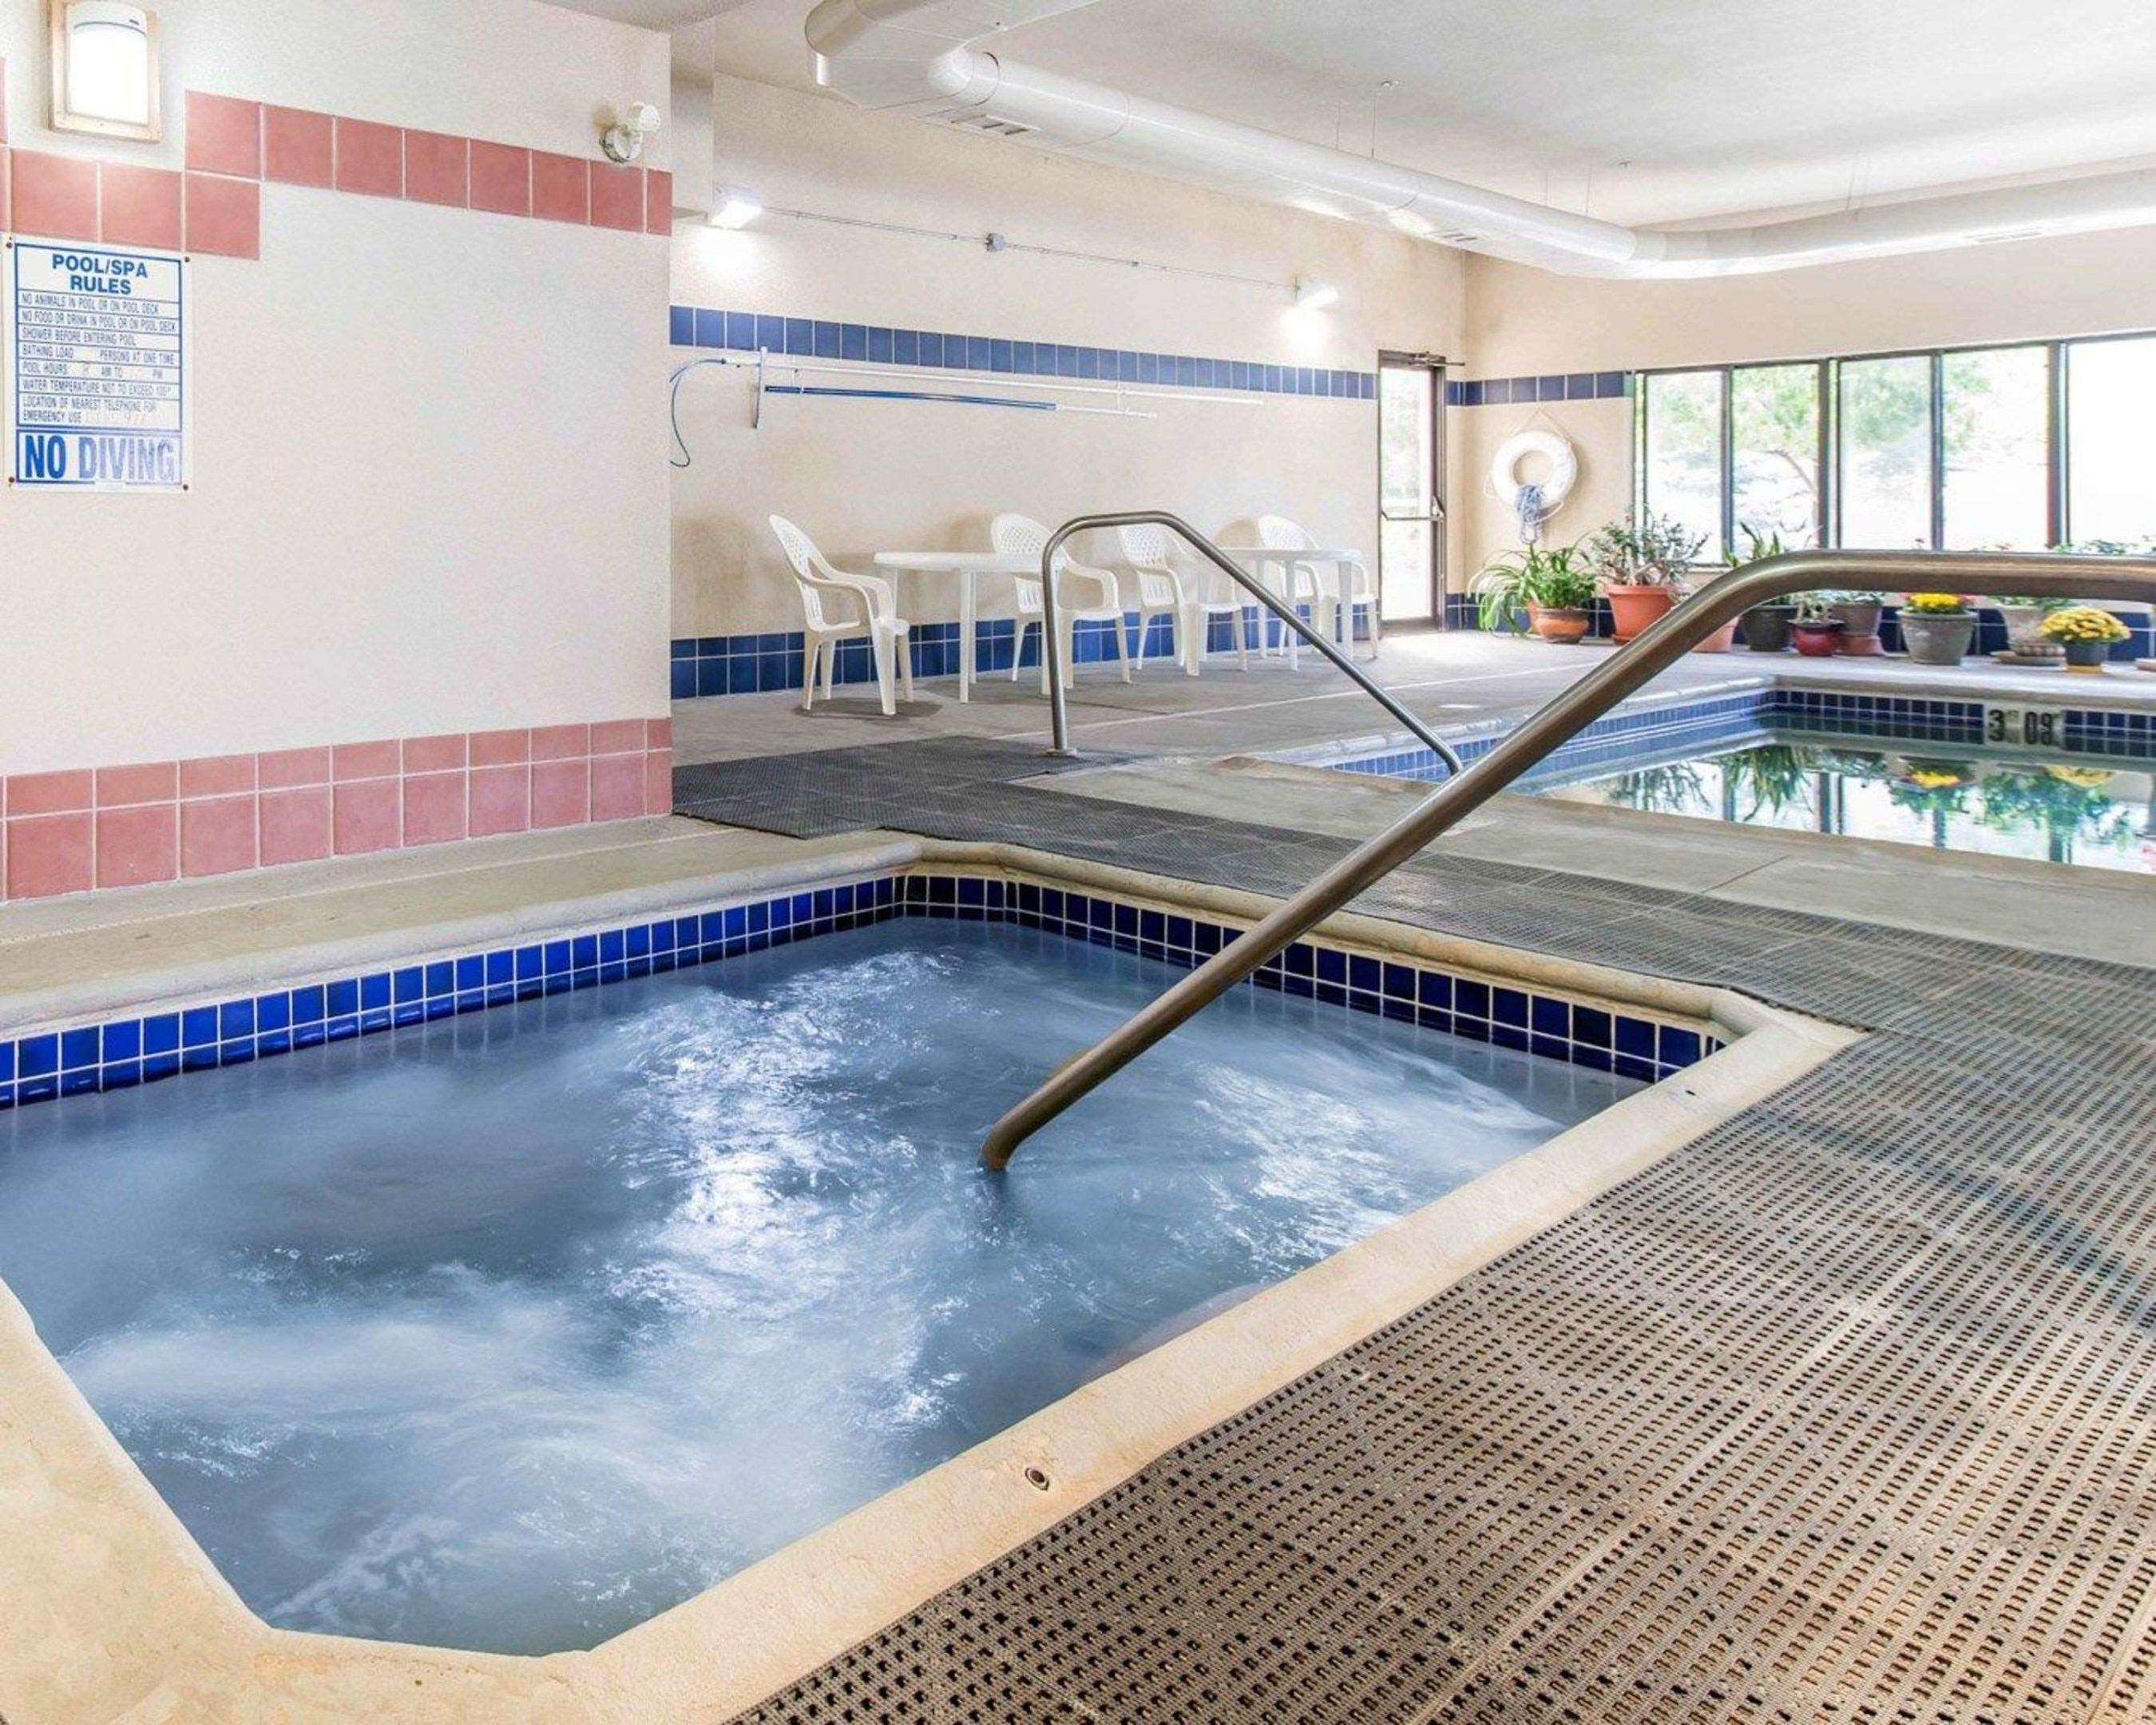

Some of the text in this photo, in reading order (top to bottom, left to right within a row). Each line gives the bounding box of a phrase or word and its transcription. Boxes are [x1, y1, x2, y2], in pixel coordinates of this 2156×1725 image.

[52, 253, 148, 278] POOL/SPA
[70, 275, 132, 295] RULES
[22, 293, 159, 315] NO ANIMALS IN POOL OR ON POOL DECK
[22, 309, 176, 332] NO FOOD OR DRINK IN POOL OR ON POOL DECK
[22, 327, 137, 346] SHOWER BEFORE ENTERING POOL
[22, 344, 174, 366] BATHING LOAD PERSONS AT ONE TIME
[22, 361, 41, 373] POOL
[101, 366, 111, 377] AM
[115, 367, 123, 379] TO
[22, 379, 48, 391] WATER
[50, 379, 100, 394] TEMPERATURE
[102, 383, 115, 395] NOT
[117, 383, 127, 395] TO
[129, 384, 153, 397] EXCEED
[22, 395, 157, 414] LOCATION OF NEAREST TELEPHONE FOR
[22, 409, 65, 422] EMERGENCY
[69, 411, 81, 423] USE
[25, 435, 176, 482] NO DIVING
